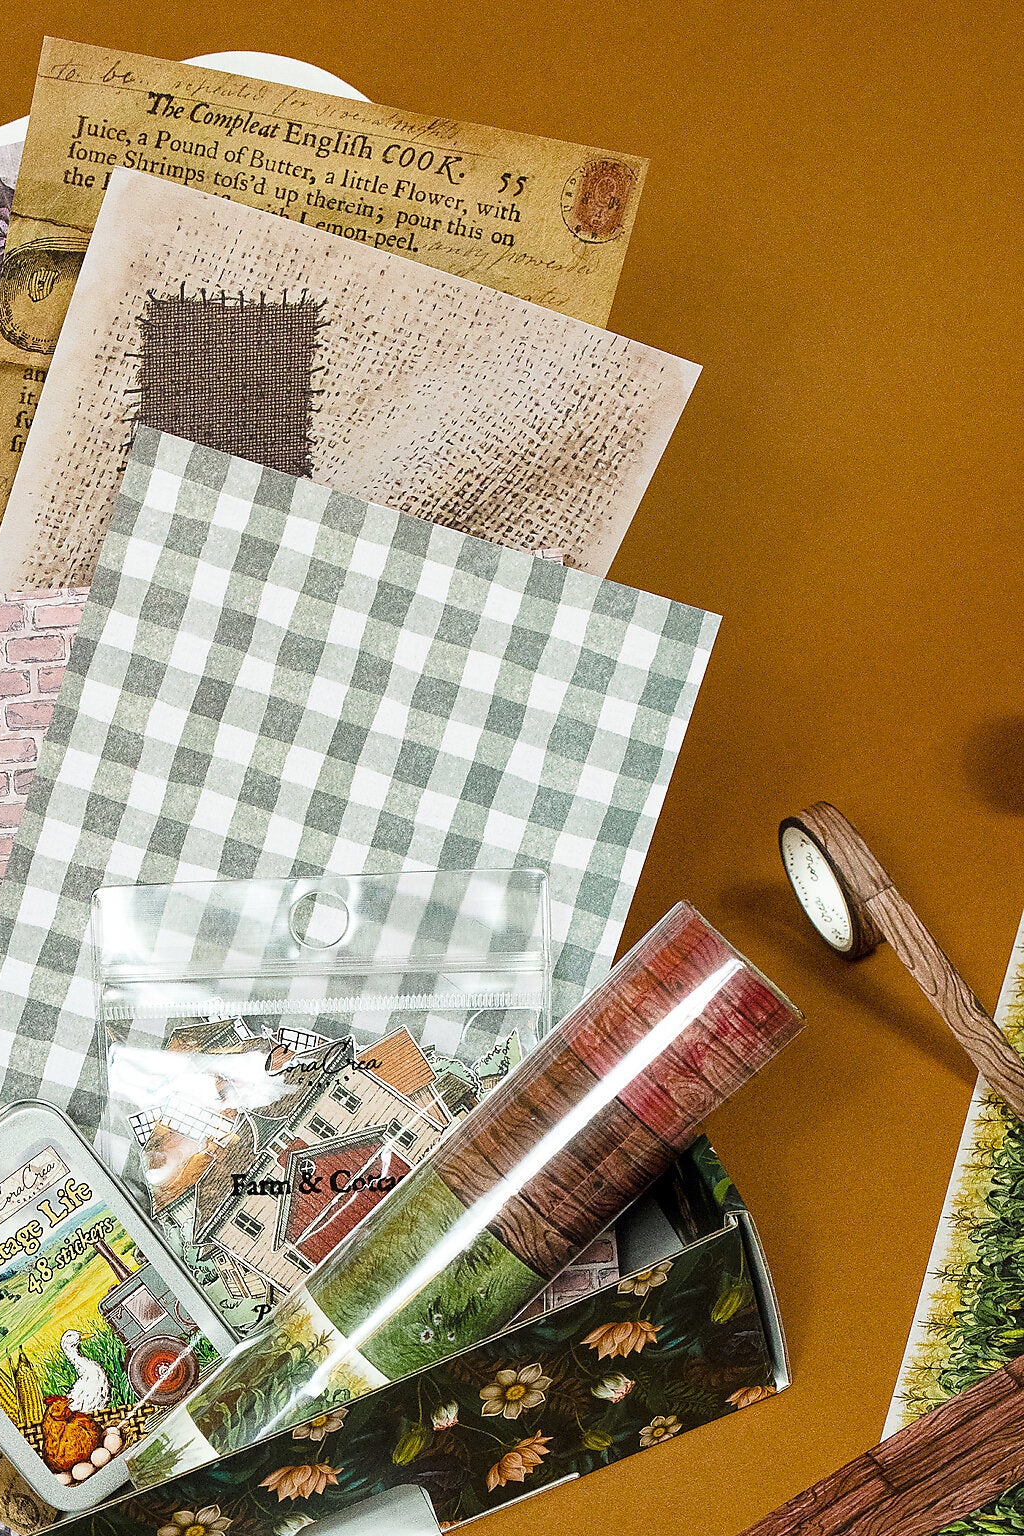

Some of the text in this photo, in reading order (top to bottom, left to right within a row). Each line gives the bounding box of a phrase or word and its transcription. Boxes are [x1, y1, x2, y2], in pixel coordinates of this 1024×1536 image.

[62, 165, 96, 189] the
[70, 114, 522, 224] Juice, Pound Butter, little Flower, with
[145, 90, 187, 121] The
[188, 98, 282, 140] Compleat
[497, 171, 529, 198] 55
[121, 149, 484, 241] Shrimps therein; pour this
[36, 1176, 92, 1227] Life
[230, 1172, 291, 1197] Farm
[298, 1174, 322, 1194] &
[24, 1211, 115, 1296] 48 stickers
